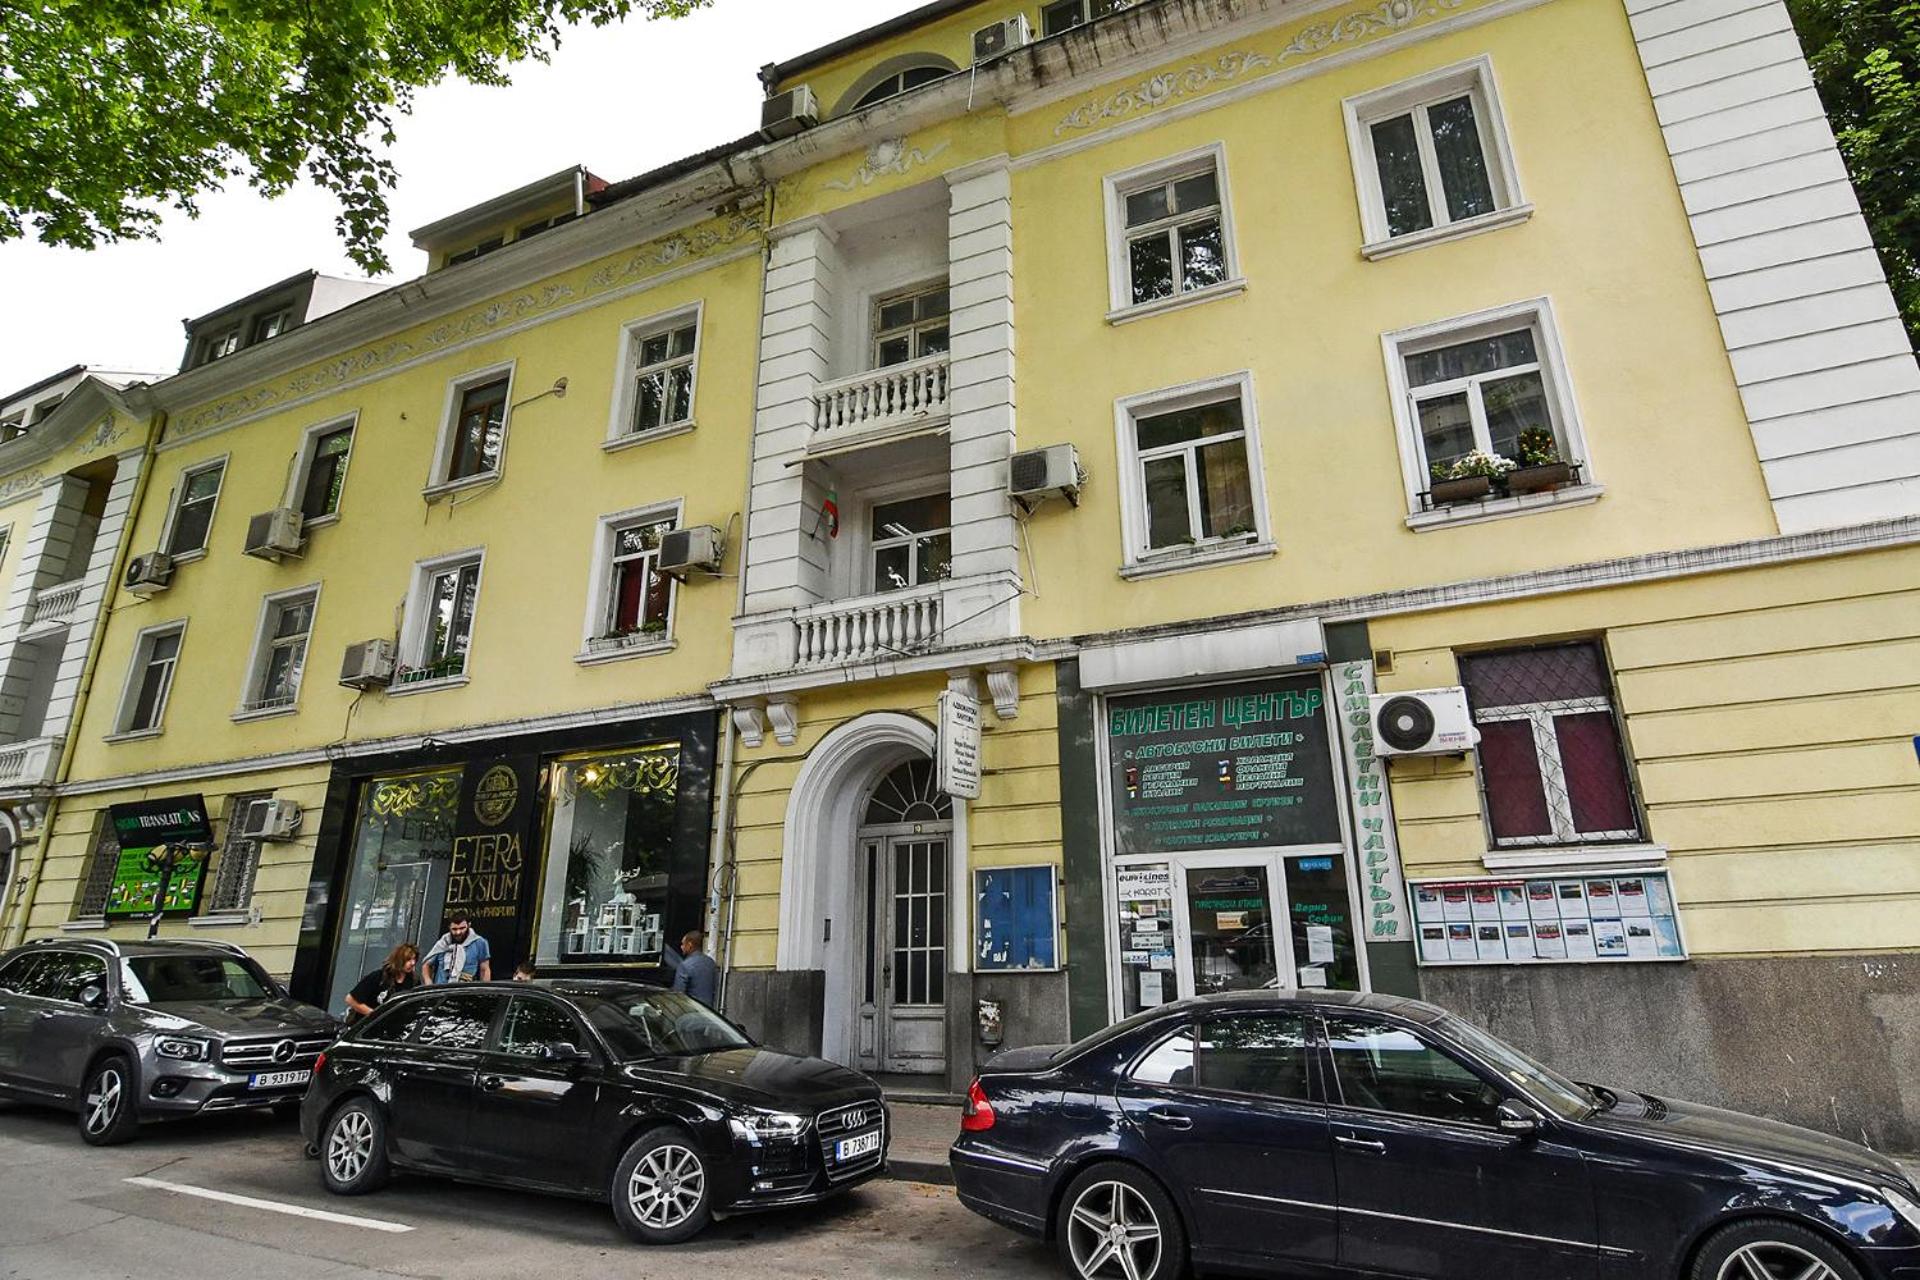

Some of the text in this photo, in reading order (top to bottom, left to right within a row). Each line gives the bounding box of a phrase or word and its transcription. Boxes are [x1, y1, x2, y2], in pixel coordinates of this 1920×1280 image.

[1109, 688, 1323, 737] БИЛЕТЕН ЦЕНТЪР
[1135, 732, 1294, 759] АВТОБУСНИ БИЛЕТИ
[1343, 663, 1398, 936] САМОЛЕТНИ ЧАРТЪРИ
[449, 832, 522, 875] ETERA
[446, 872, 521, 904] ELYSIUM
[272, 1072, 296, 1085] 9319
